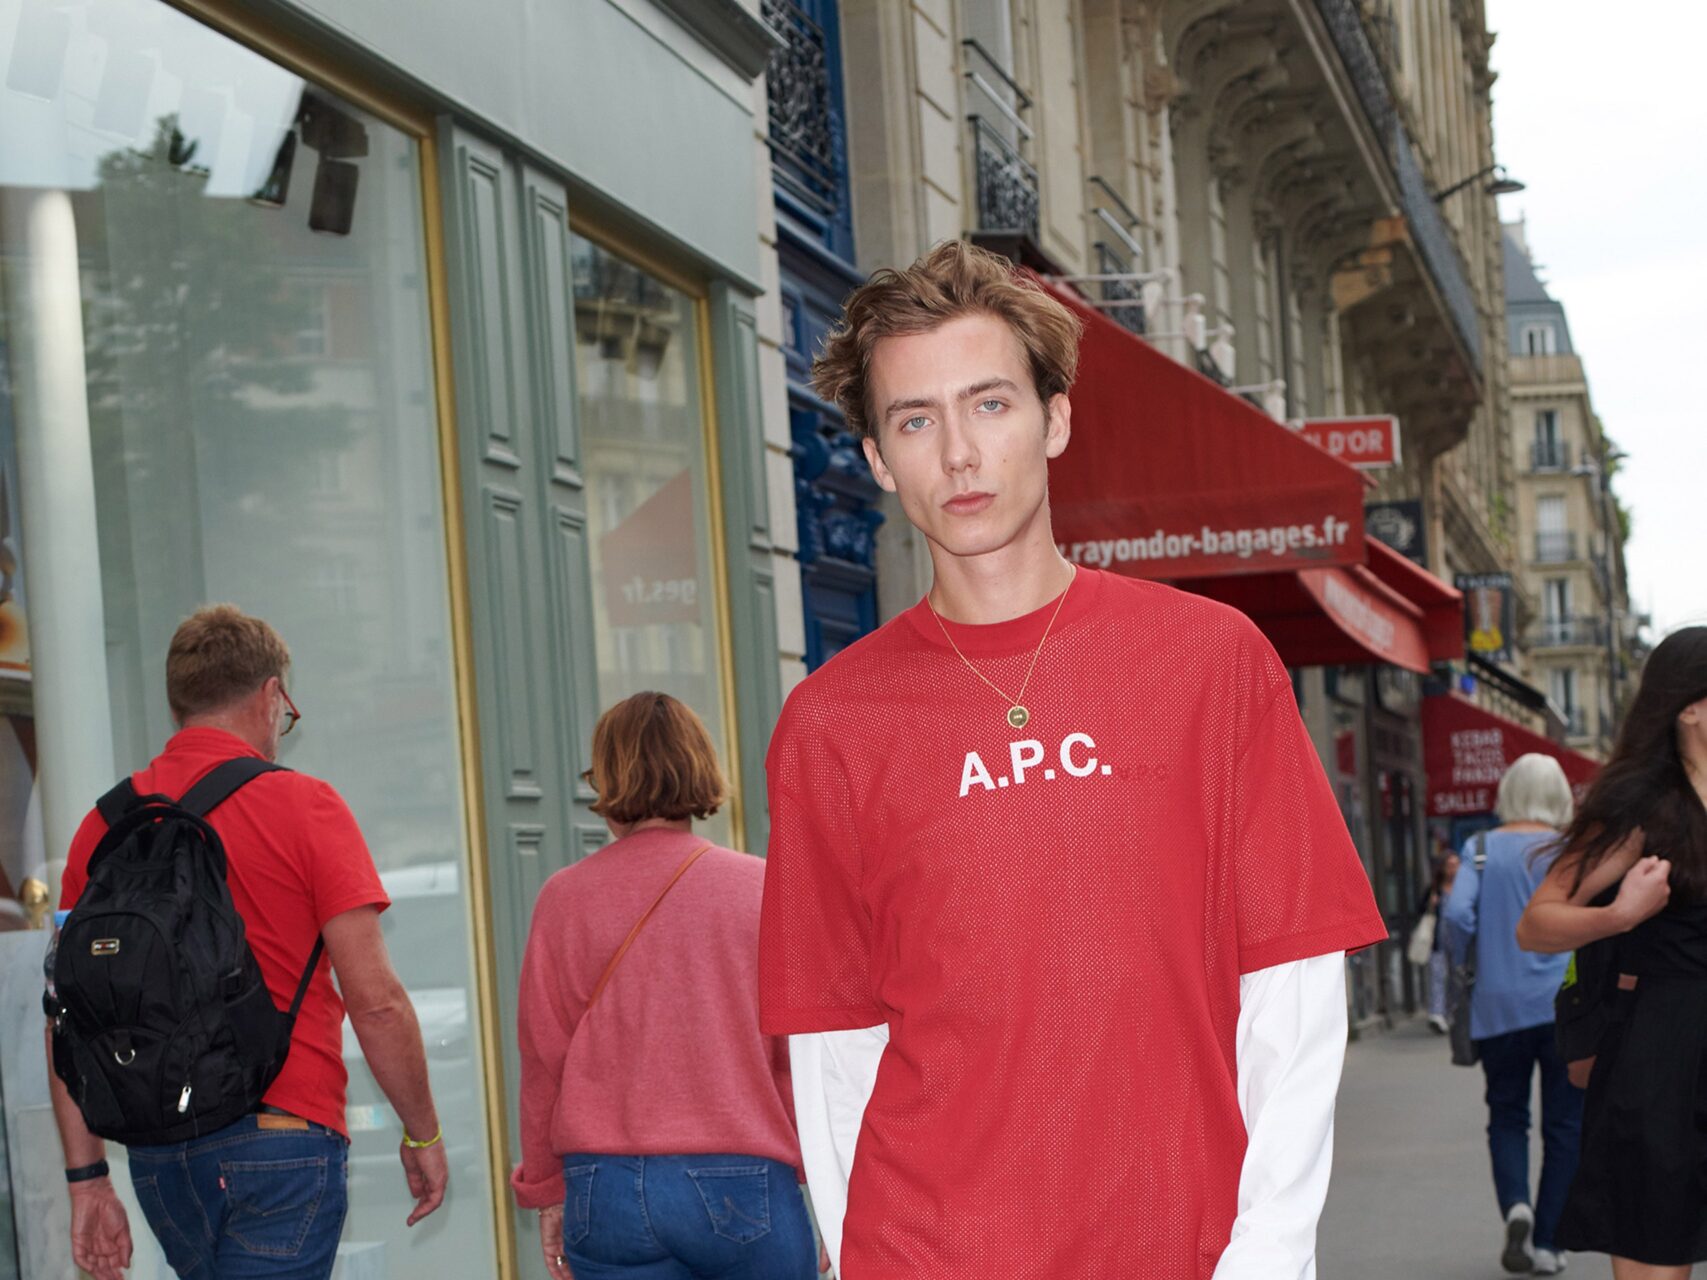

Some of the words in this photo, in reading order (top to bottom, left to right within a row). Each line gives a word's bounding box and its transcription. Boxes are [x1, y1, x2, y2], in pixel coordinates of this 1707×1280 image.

[1328, 428, 1384, 457] D'OR
[1451, 729, 1504, 748] KEBAB
[959, 732, 1112, 798] A.P.C.
[1453, 748, 1505, 767] TACOS
[1434, 789, 1490, 814] SALLE
